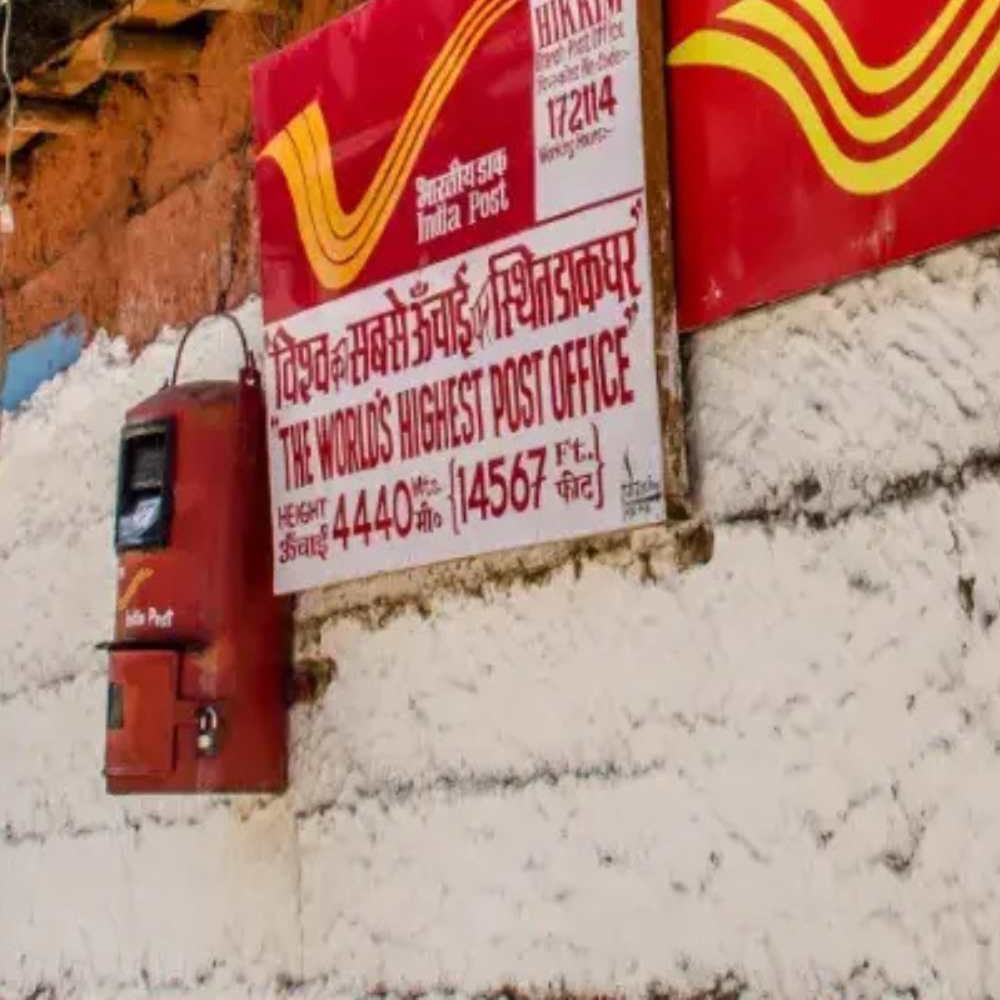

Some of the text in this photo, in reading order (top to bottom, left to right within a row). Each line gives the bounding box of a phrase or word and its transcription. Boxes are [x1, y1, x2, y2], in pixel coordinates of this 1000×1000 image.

[547, 74, 617, 139] 172114
[417, 178, 509, 244] India Post
[347, 286, 410, 386] सबसे
[397, 367, 485, 461] HIGHEST
[489, 349, 545, 438] POST
[278, 496, 327, 530] HEIGHT
[333, 478, 414, 551] 4440
